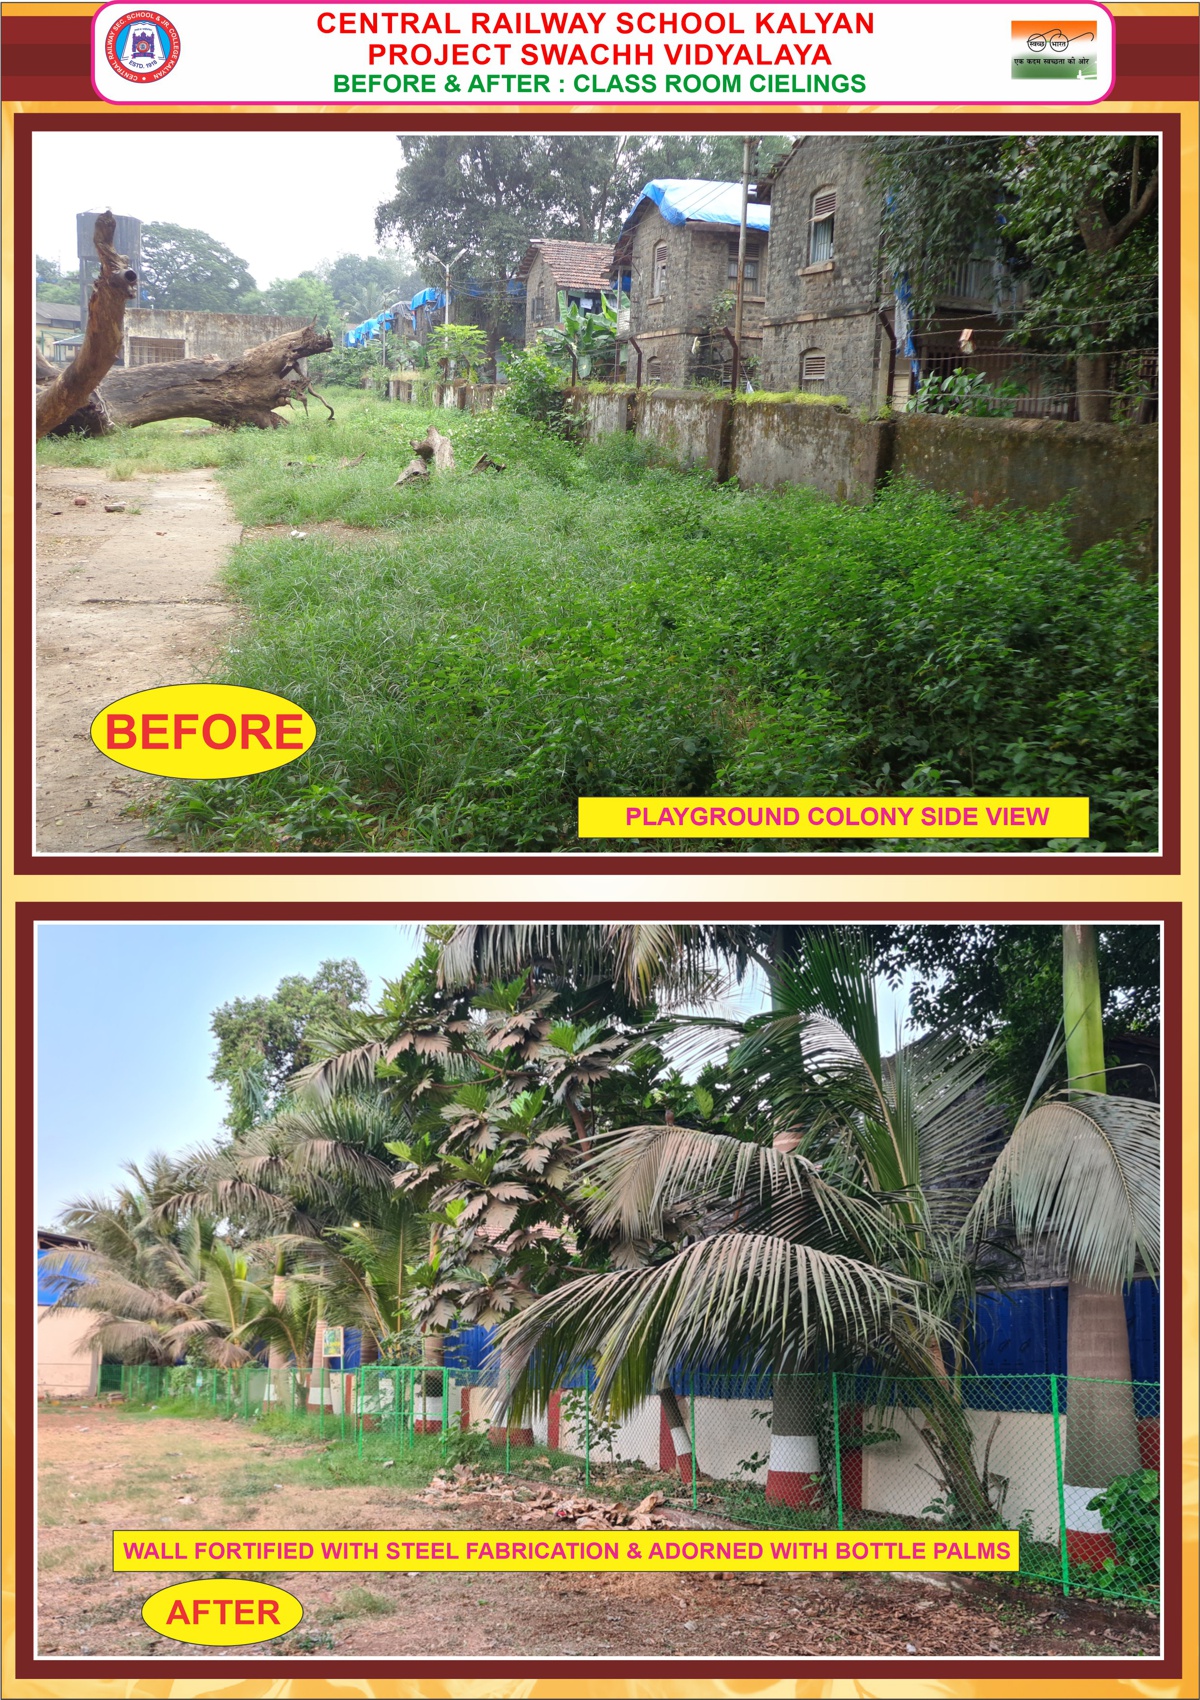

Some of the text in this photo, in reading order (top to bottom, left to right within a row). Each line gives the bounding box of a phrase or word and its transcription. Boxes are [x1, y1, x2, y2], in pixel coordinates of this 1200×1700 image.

[126, 12, 154, 20] SCHOOL
[317, 12, 873, 34] CENTRAL RAILWAY SCHOOL KALYAN
[107, 32, 115, 59] RAILWAY
[169, 28, 179, 59] COLLEGE
[369, 44, 831, 65] PROJECT SWACHH VIDYALAYA
[1013, 58, 1025, 66] एक
[1067, 56, 1076, 65] की
[111, 60, 138, 81] CENTRAL
[153, 59, 176, 80] KALYAN
[334, 74, 436, 93] BEFORE
[444, 74, 461, 93] &
[468, 74, 551, 93] AFTER
[574, 74, 657, 93] CLASS
[666, 74, 740, 93] ROOM
[750, 74, 866, 93] CIELINGS
